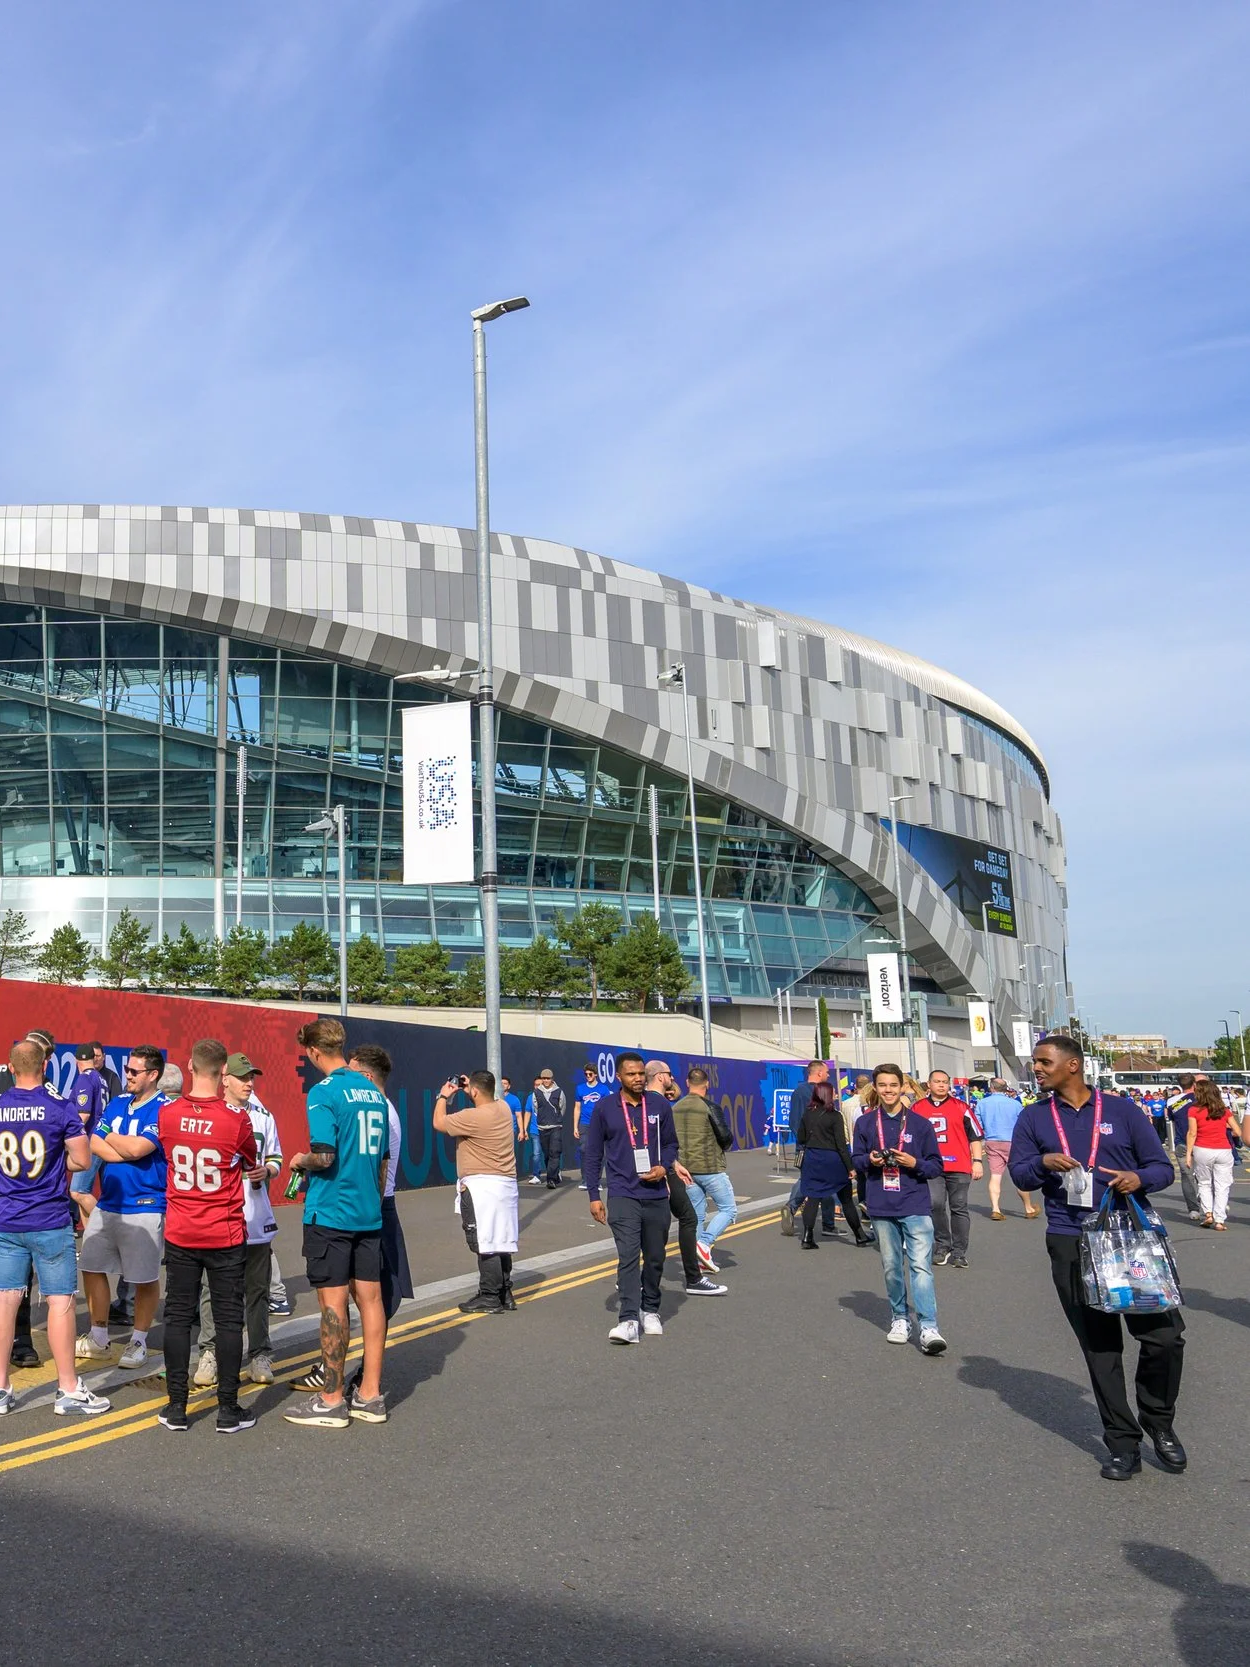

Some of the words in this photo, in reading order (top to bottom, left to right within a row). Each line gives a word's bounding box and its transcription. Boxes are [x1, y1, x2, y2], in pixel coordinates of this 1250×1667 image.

[988, 851, 997, 863] GET
[998, 854, 1007, 866] SET
[974, 859, 986, 873] FOR
[986, 863, 1009, 879] GAMEDAY
[879, 966, 890, 1007] verizon
[597, 1052, 616, 1084] GO
[343, 1088, 384, 1105] LAWRENCE
[180, 1117, 214, 1136] ERTZ
[357, 1110, 384, 1155] 16
[171, 1145, 222, 1193] 86
[1132, 1268, 1147, 1278] NFL
